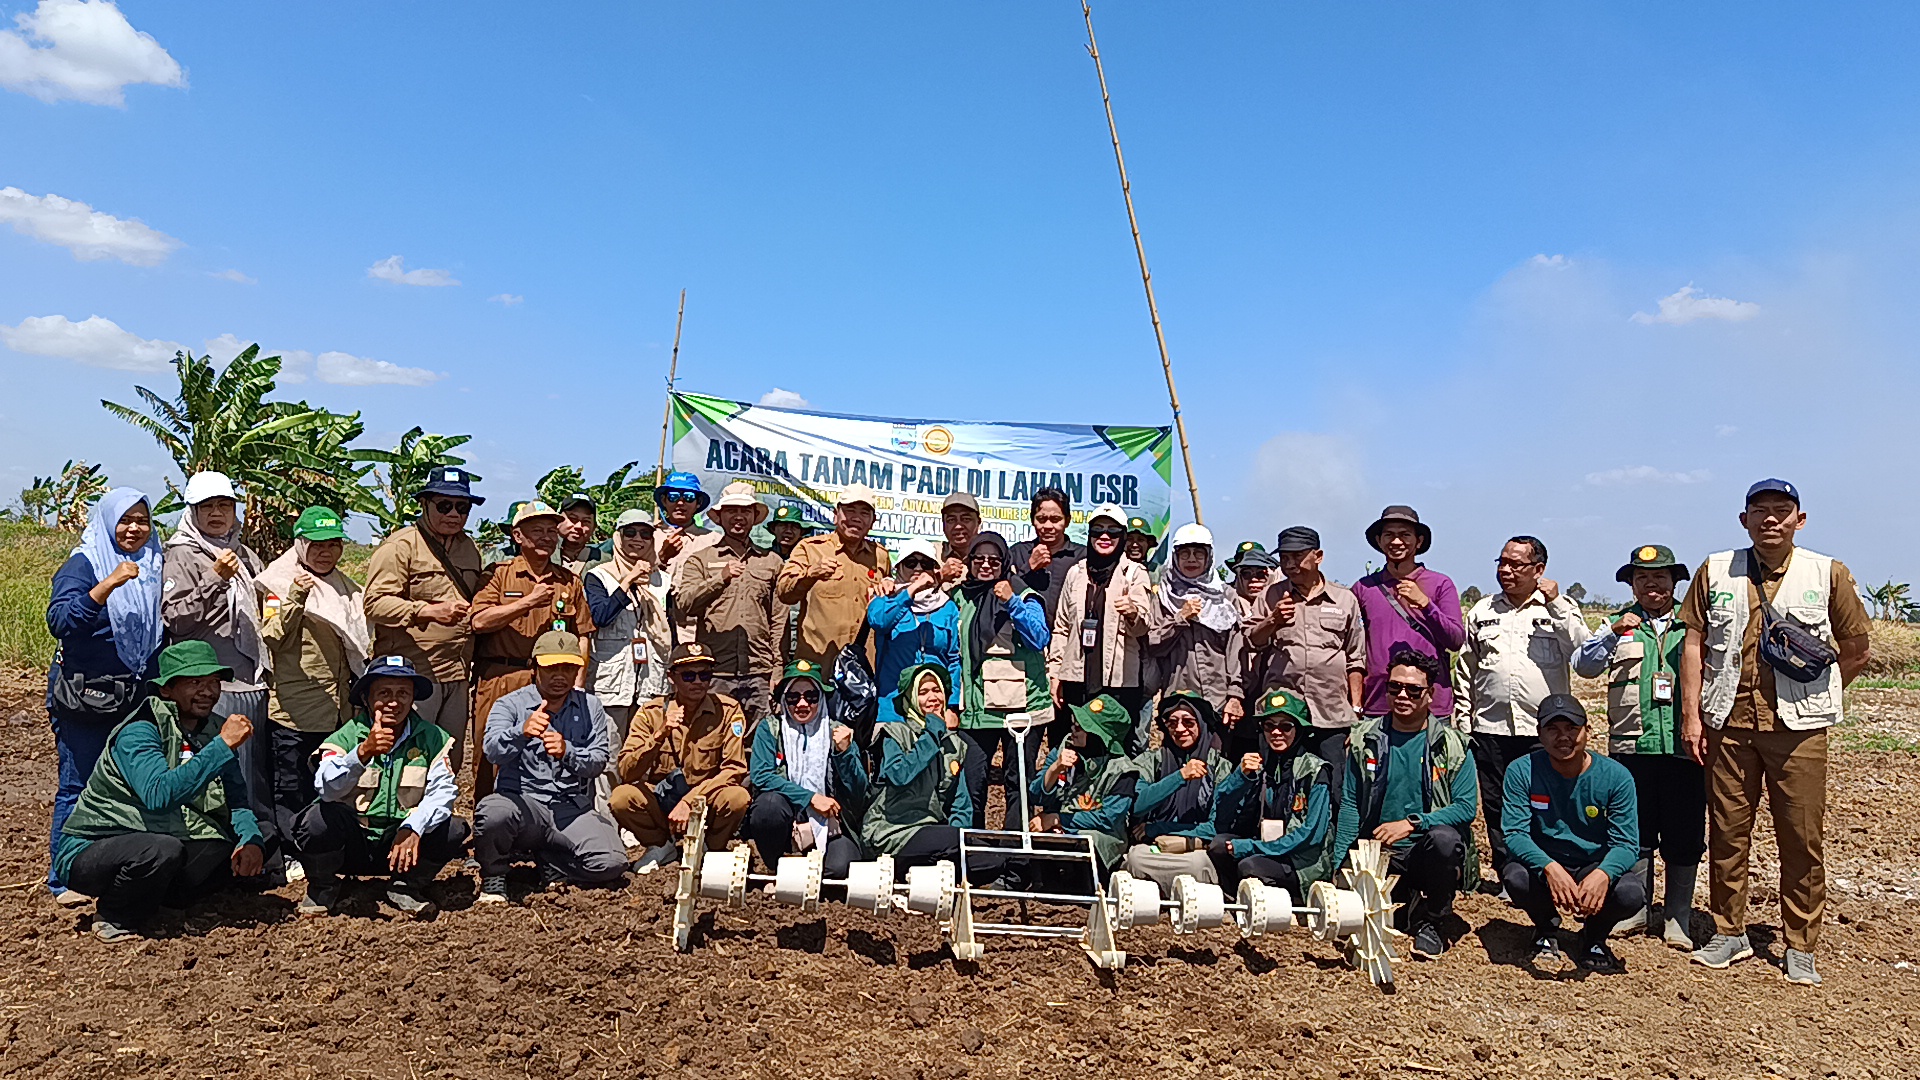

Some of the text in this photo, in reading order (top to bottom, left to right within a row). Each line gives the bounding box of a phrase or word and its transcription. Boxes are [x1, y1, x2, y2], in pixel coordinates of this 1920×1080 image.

[705, 438, 1138, 507] ACARA TANAM PADI DI LAHAN CSR
